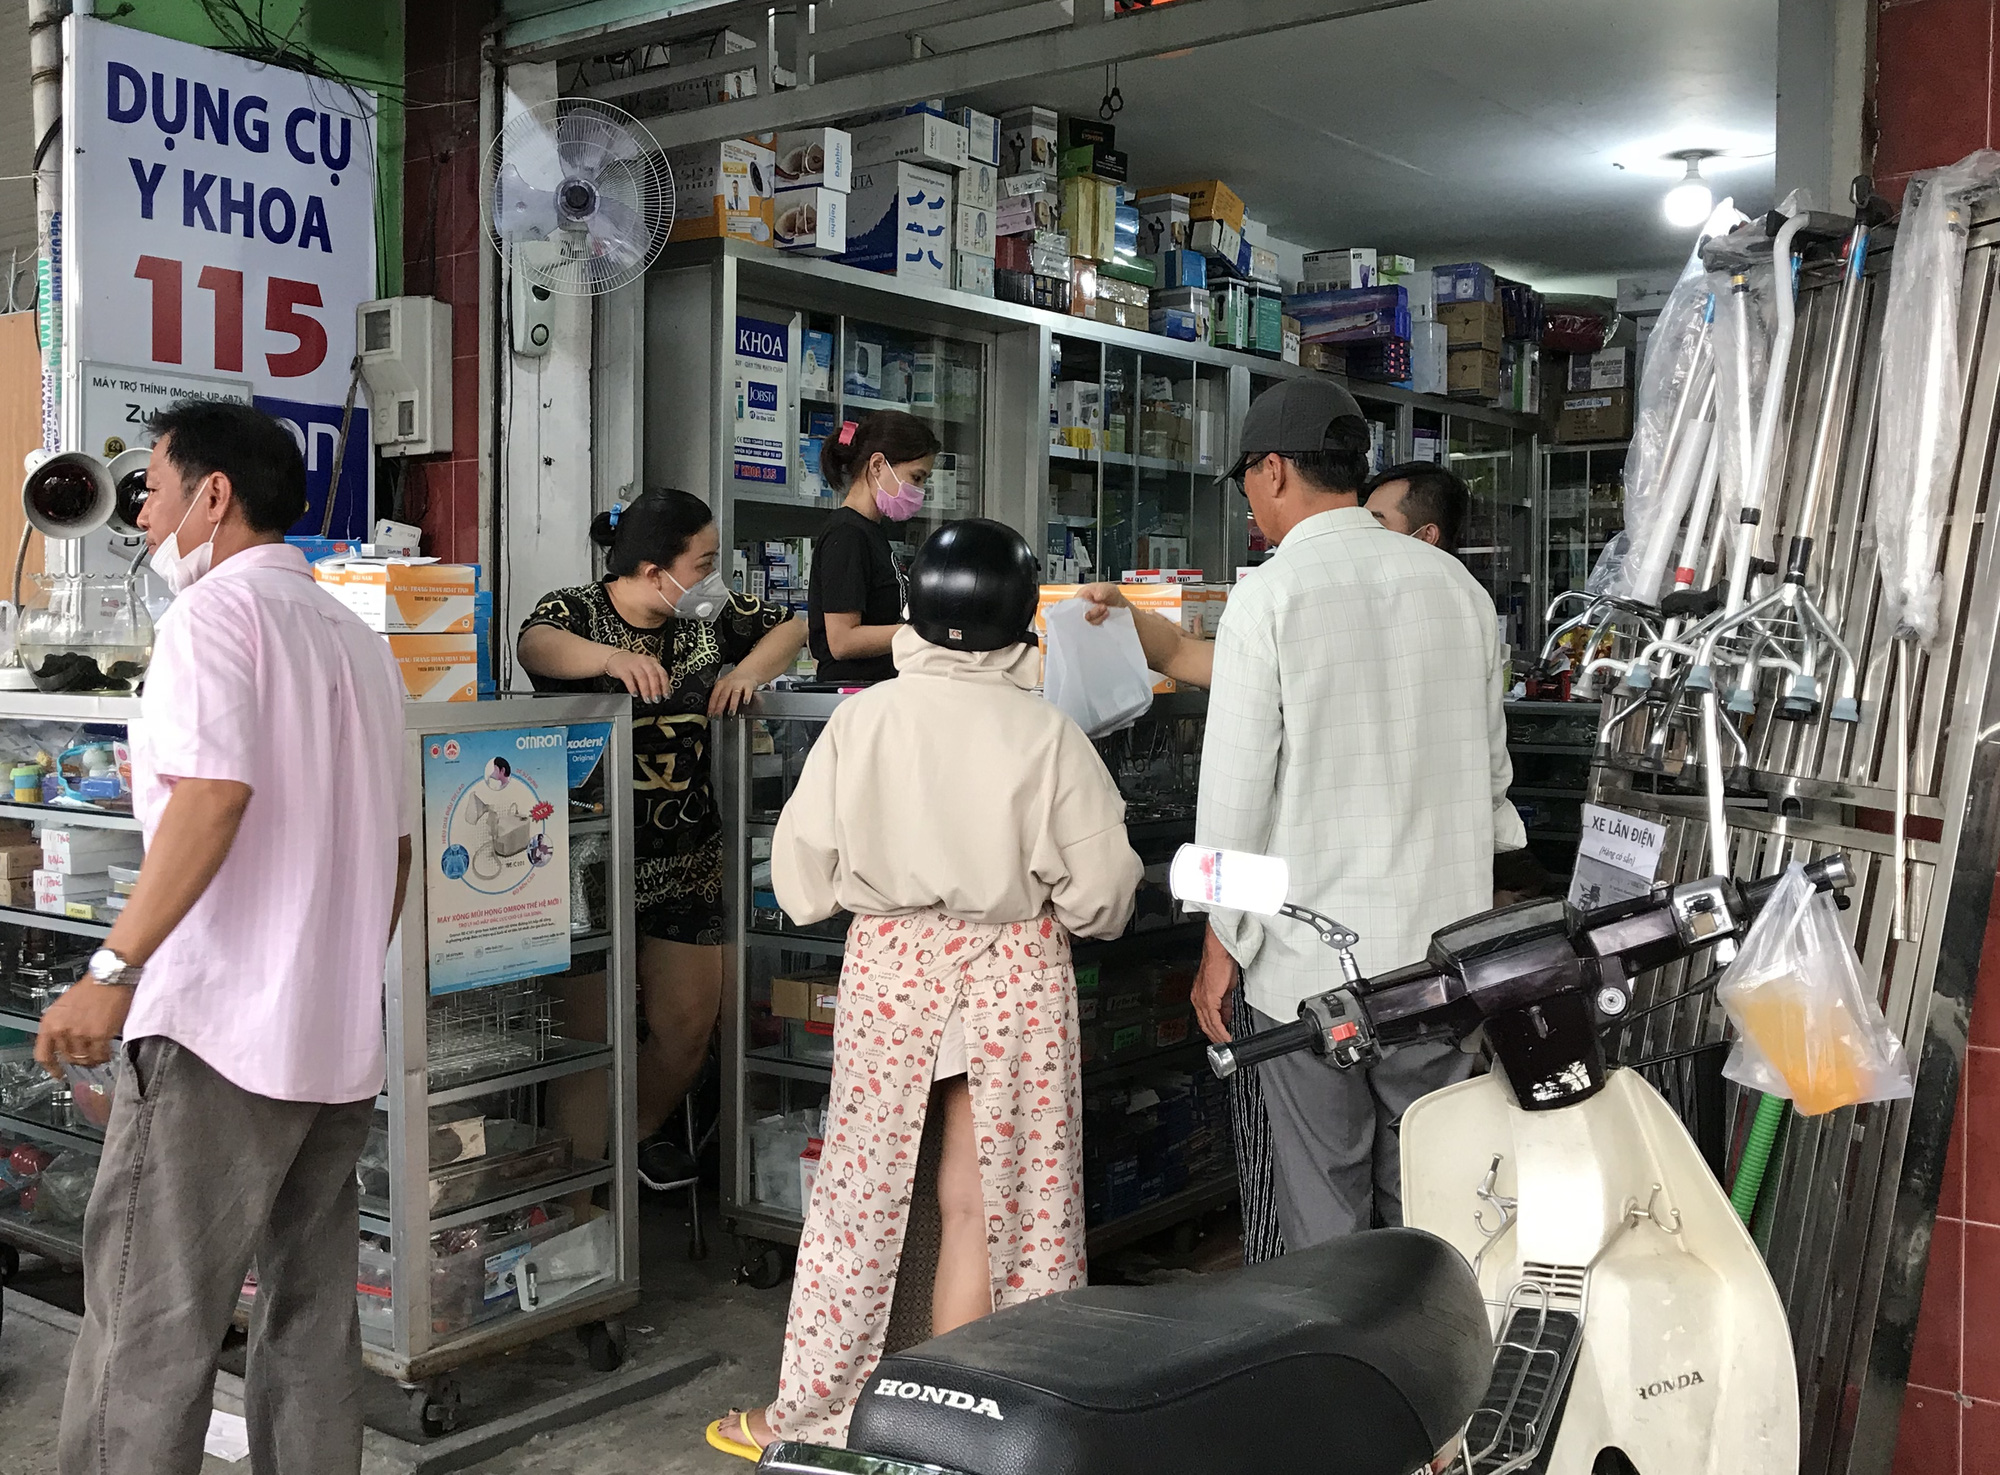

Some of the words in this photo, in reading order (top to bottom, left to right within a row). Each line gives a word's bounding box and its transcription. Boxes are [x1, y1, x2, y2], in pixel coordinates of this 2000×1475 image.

[107, 60, 270, 152] DỤNG
[285, 108, 352, 187] CỤ
[129, 157, 166, 220] Y
[183, 169, 333, 253] KHOA
[134, 254, 328, 378] 115
[740, 329, 784, 358] KHOA
[93, 376, 117, 389] MÁY
[119, 380, 138, 393] TRỢ
[140, 381, 167, 395] THÍNH
[741, 465, 761, 478] KHOA
[762, 467, 777, 479] 115
[572, 754, 595, 762] Original
[1592, 815, 1606, 832] XE
[1608, 819, 1630, 839] LĂN
[1631, 827, 1656, 848] ĐIỆN
[1615, 851, 1623, 861] có
[502, 904, 526, 914] OMRON
[874, 1378, 1004, 1420] HONDA
